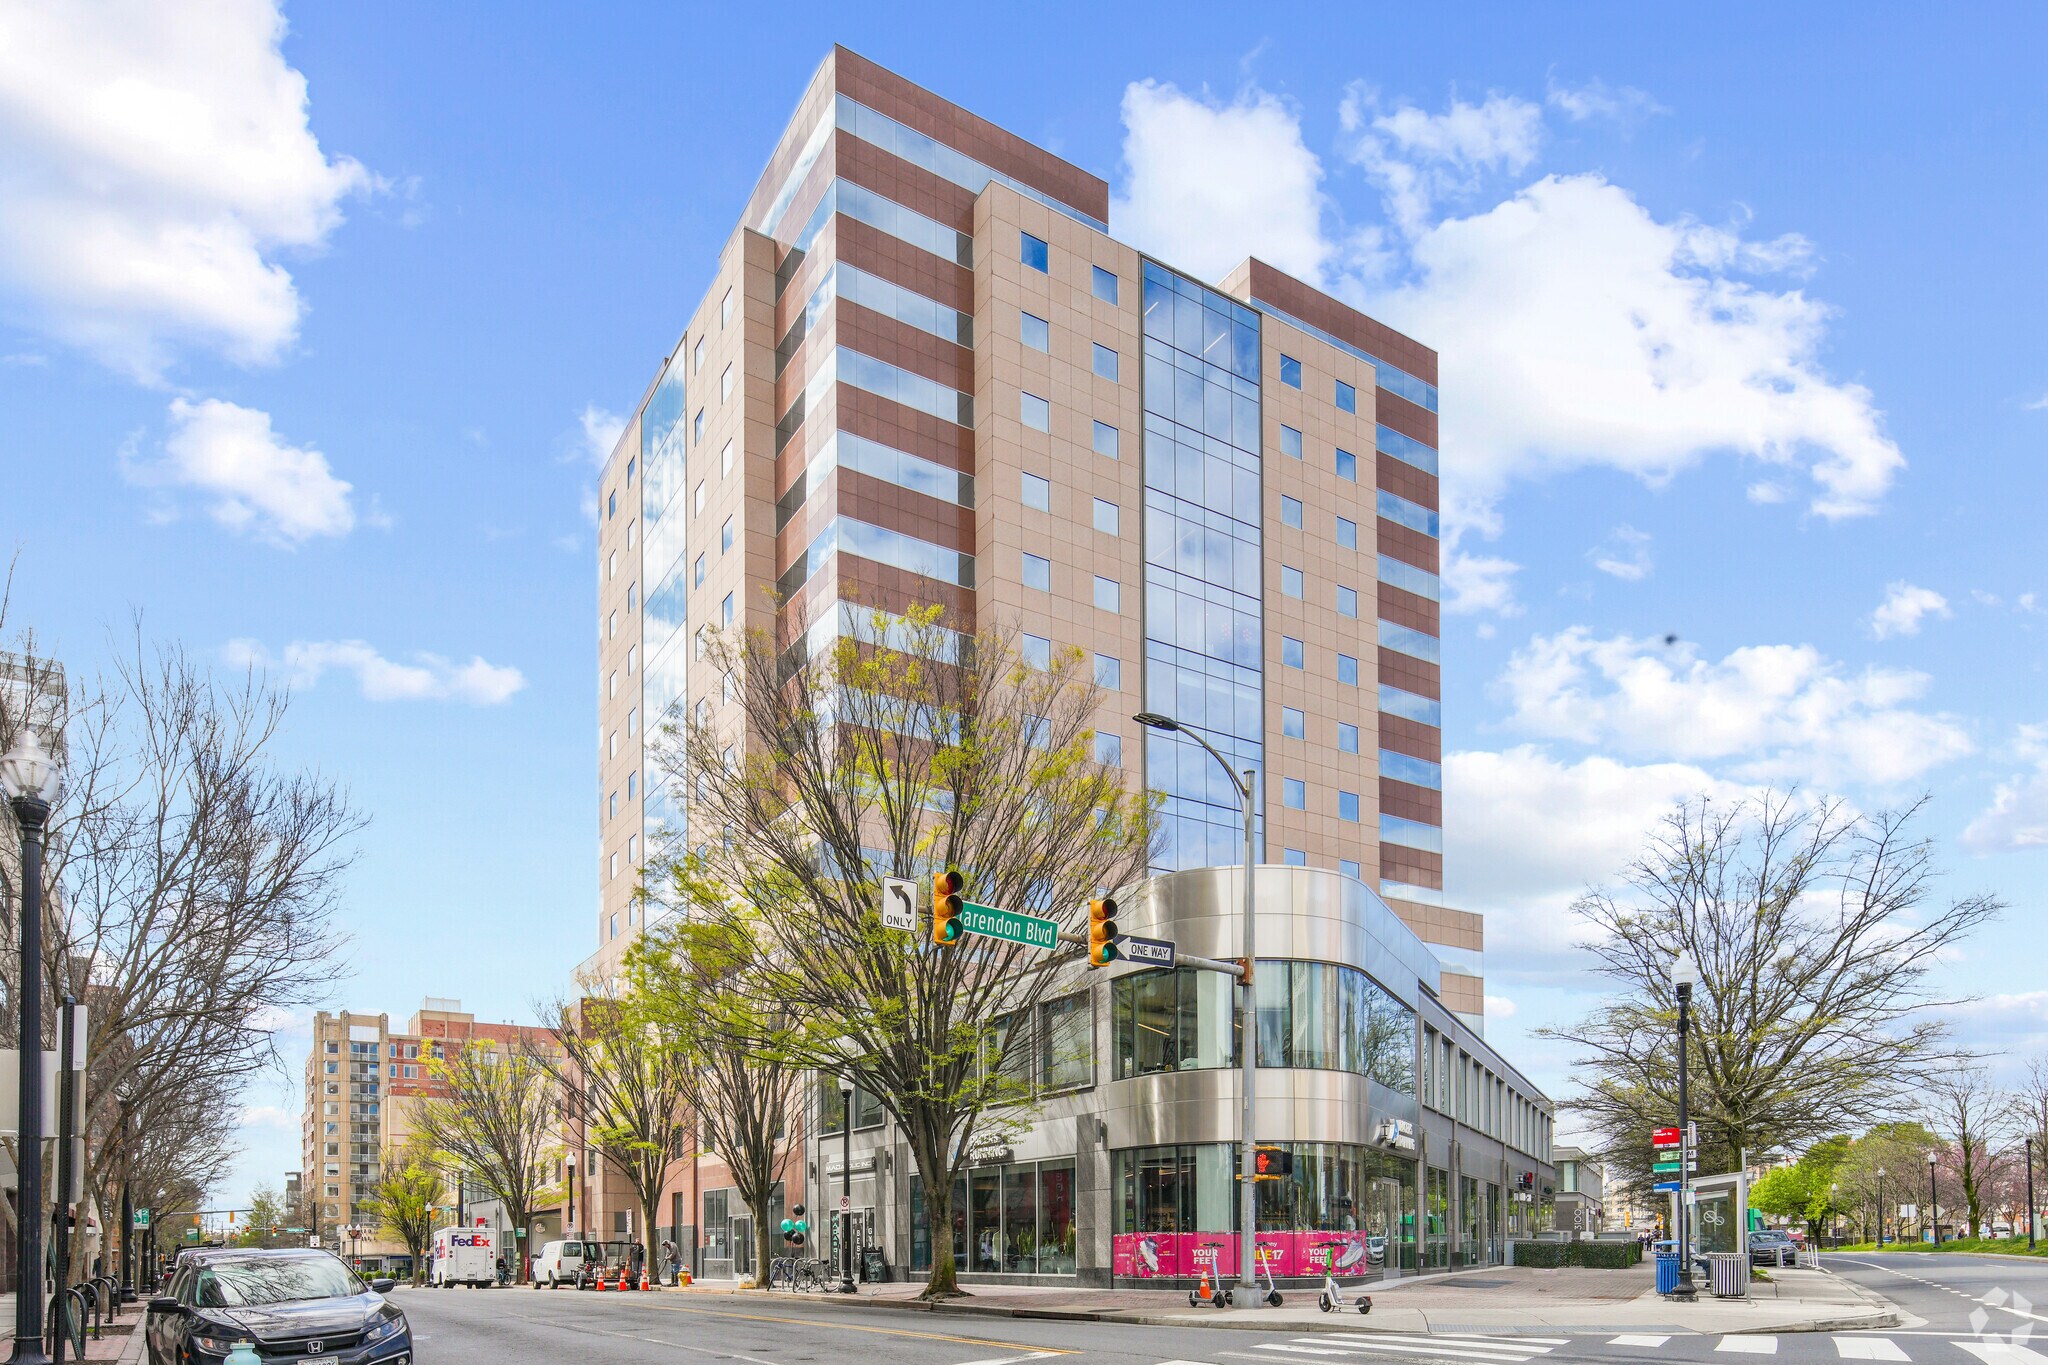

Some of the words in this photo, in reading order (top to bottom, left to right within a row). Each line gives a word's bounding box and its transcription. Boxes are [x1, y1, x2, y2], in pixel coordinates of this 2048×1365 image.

[886, 915, 912, 928] ONLY
[1026, 922, 1053, 944] Blvd
[1131, 944, 1148, 956] ONE
[1151, 947, 1168, 958] WAY
[451, 1235, 491, 1247] FedEx
